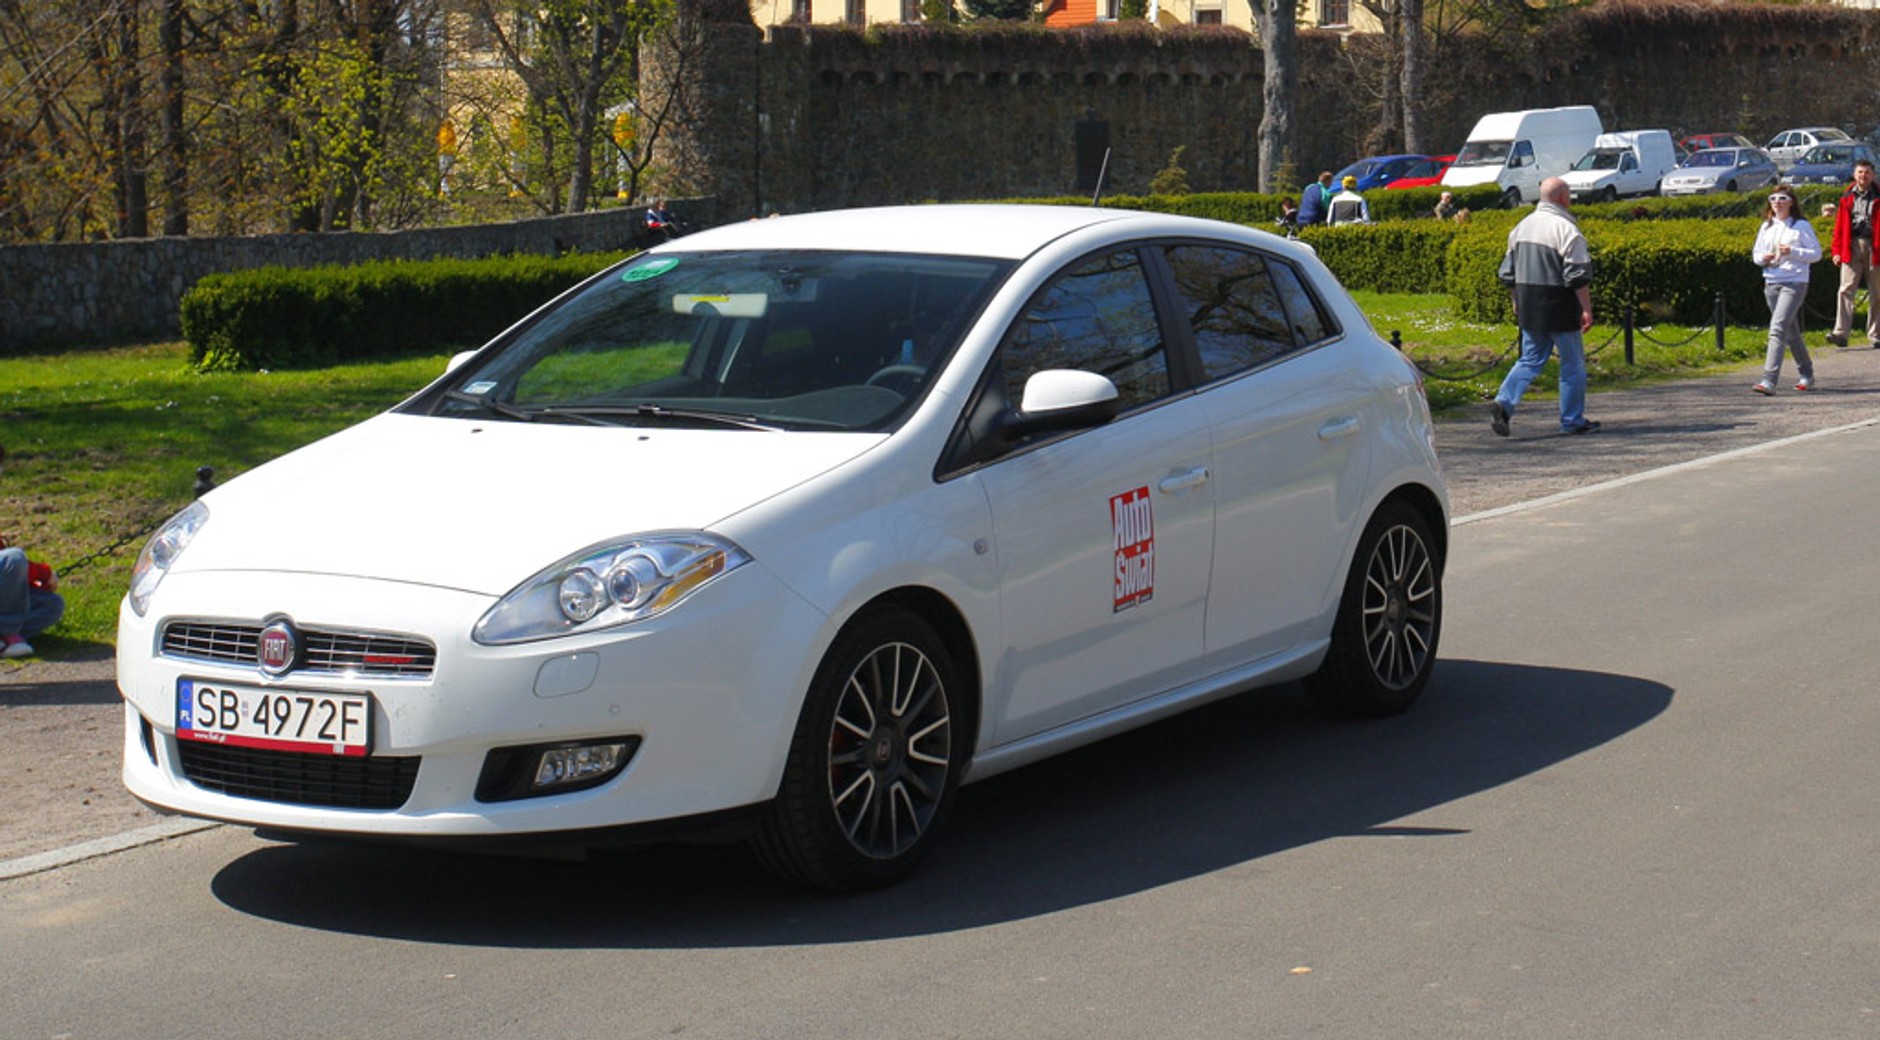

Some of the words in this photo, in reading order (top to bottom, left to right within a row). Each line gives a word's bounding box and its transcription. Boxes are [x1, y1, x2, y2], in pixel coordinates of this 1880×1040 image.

[1113, 490, 1152, 551] Auto
[264, 638, 286, 663] FIAT
[180, 710, 191, 722] PL
[198, 688, 240, 731] SB
[253, 694, 363, 742] 4972F
